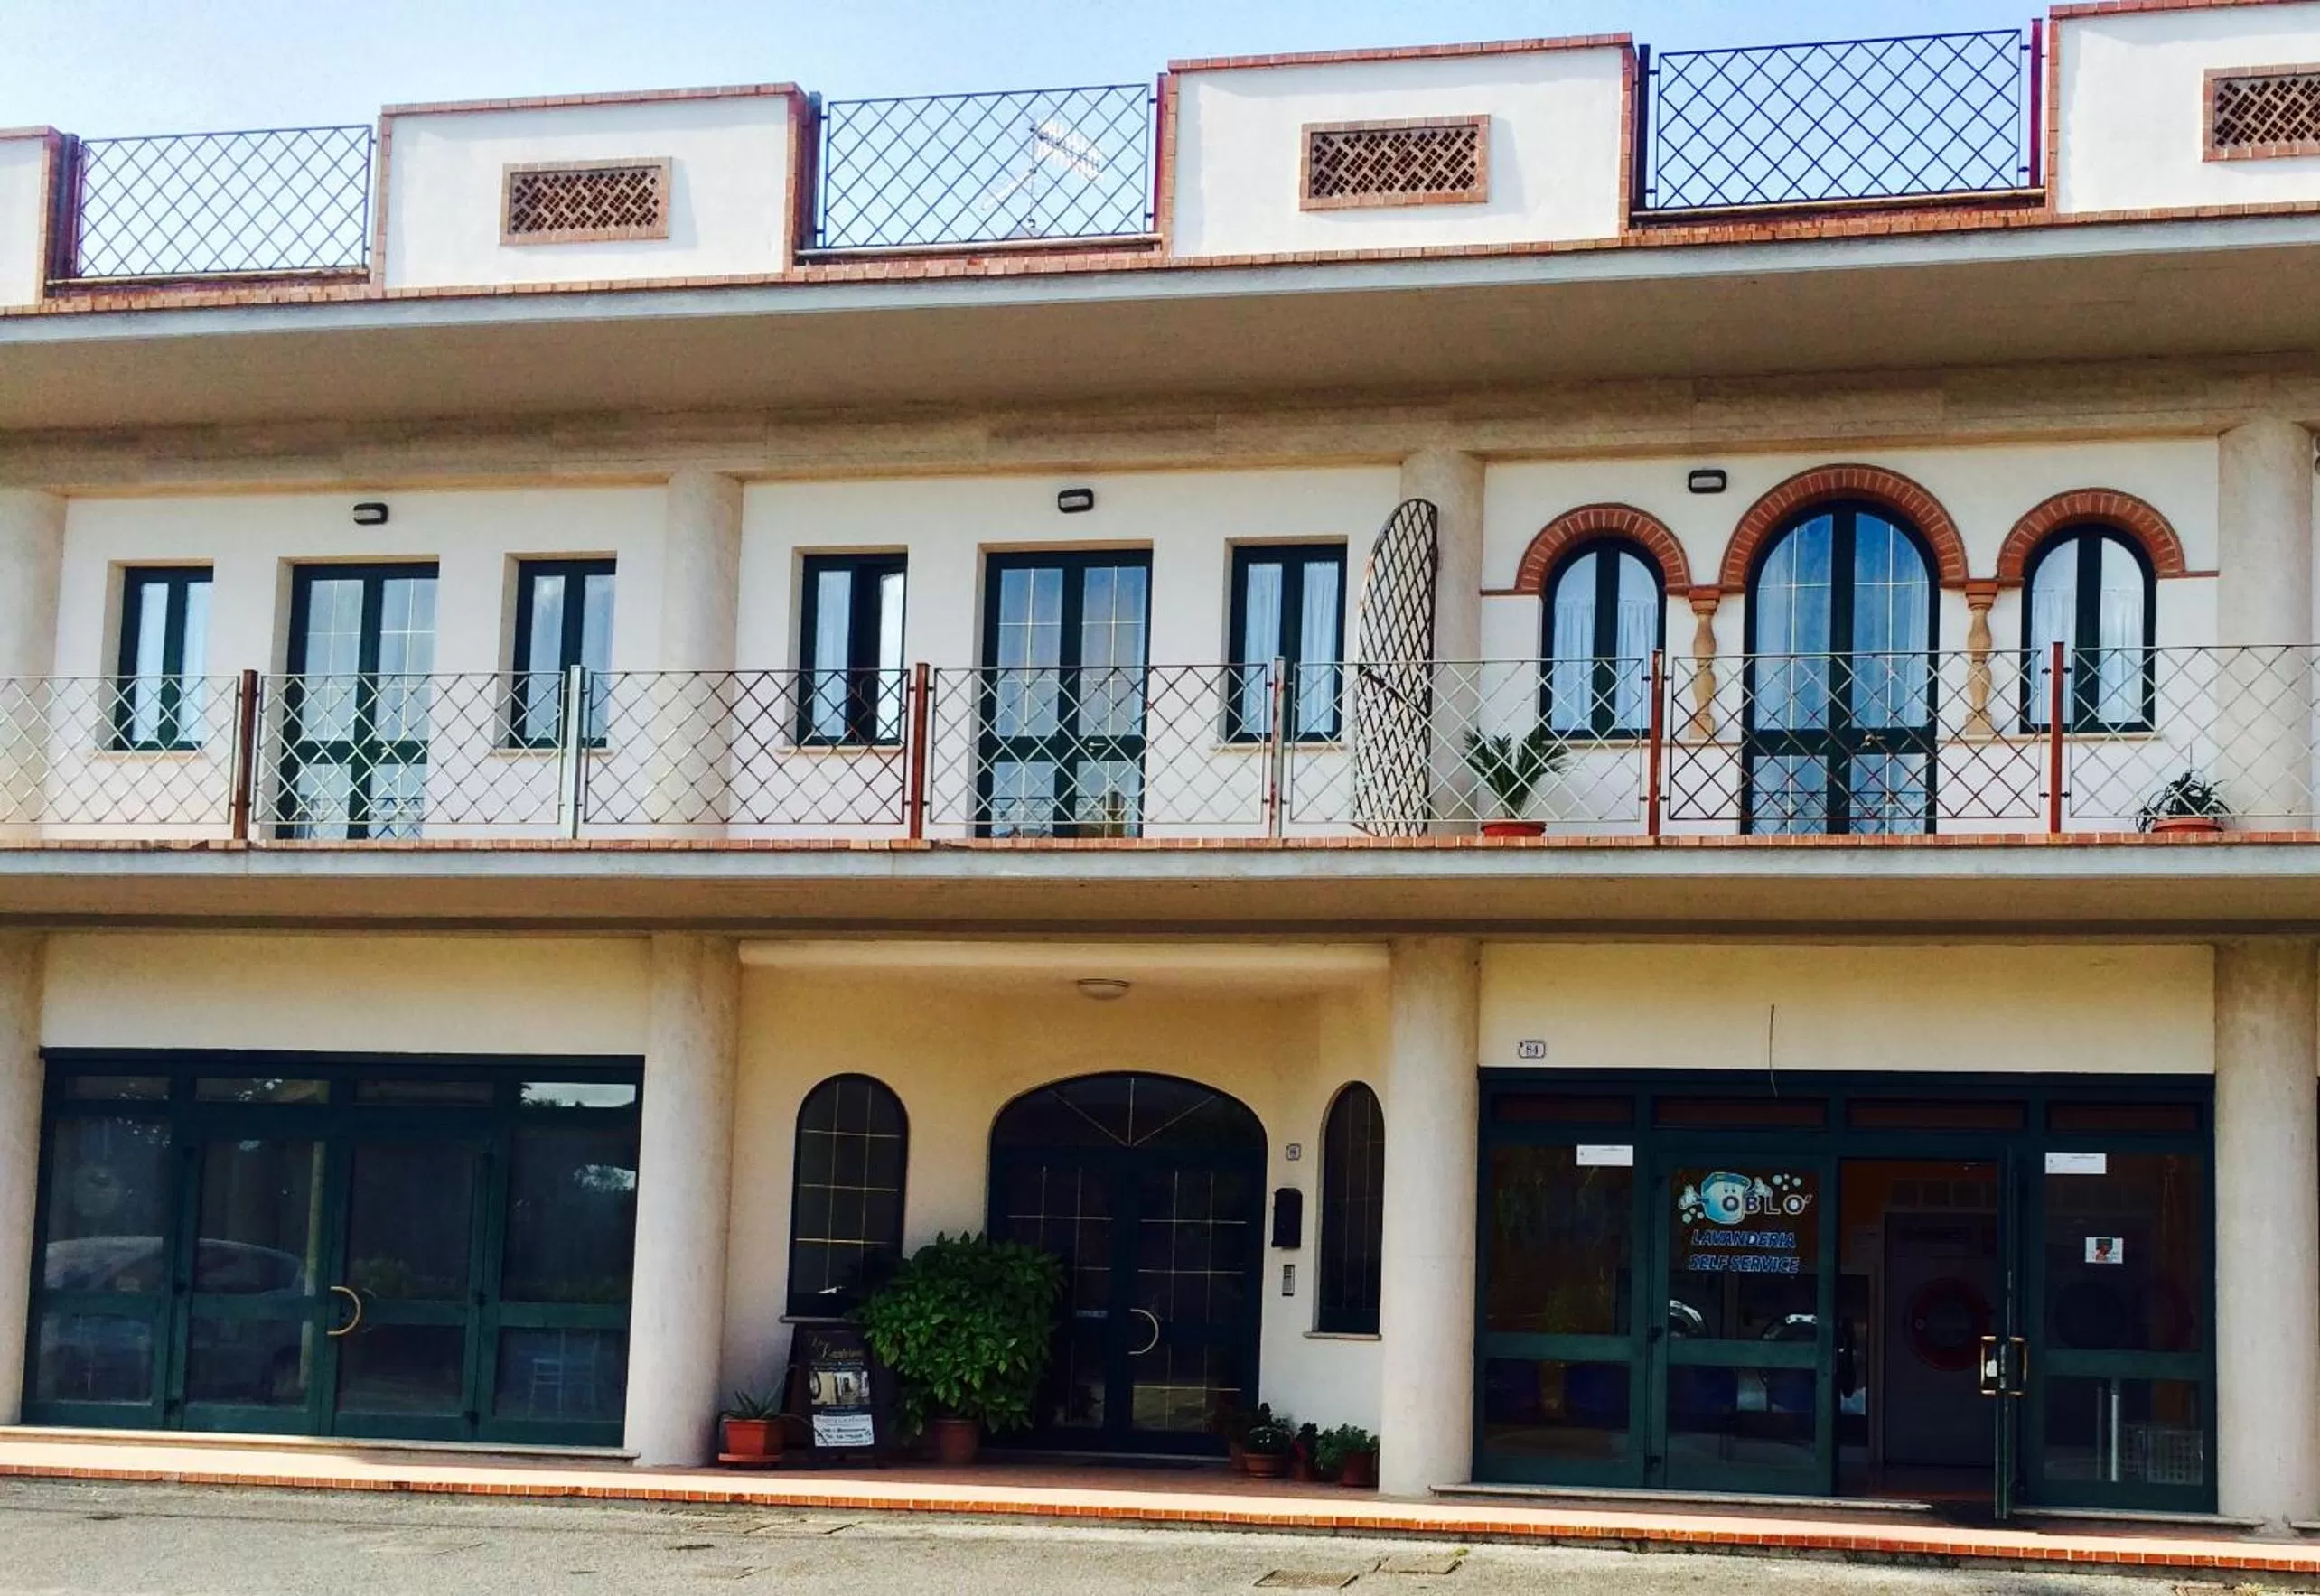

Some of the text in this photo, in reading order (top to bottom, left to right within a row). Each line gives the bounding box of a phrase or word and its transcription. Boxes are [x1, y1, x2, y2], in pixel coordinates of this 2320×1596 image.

[1691, 1229, 1797, 1248] LAVANDERIA
[1689, 1254, 1800, 1274] SELF SERVICE
